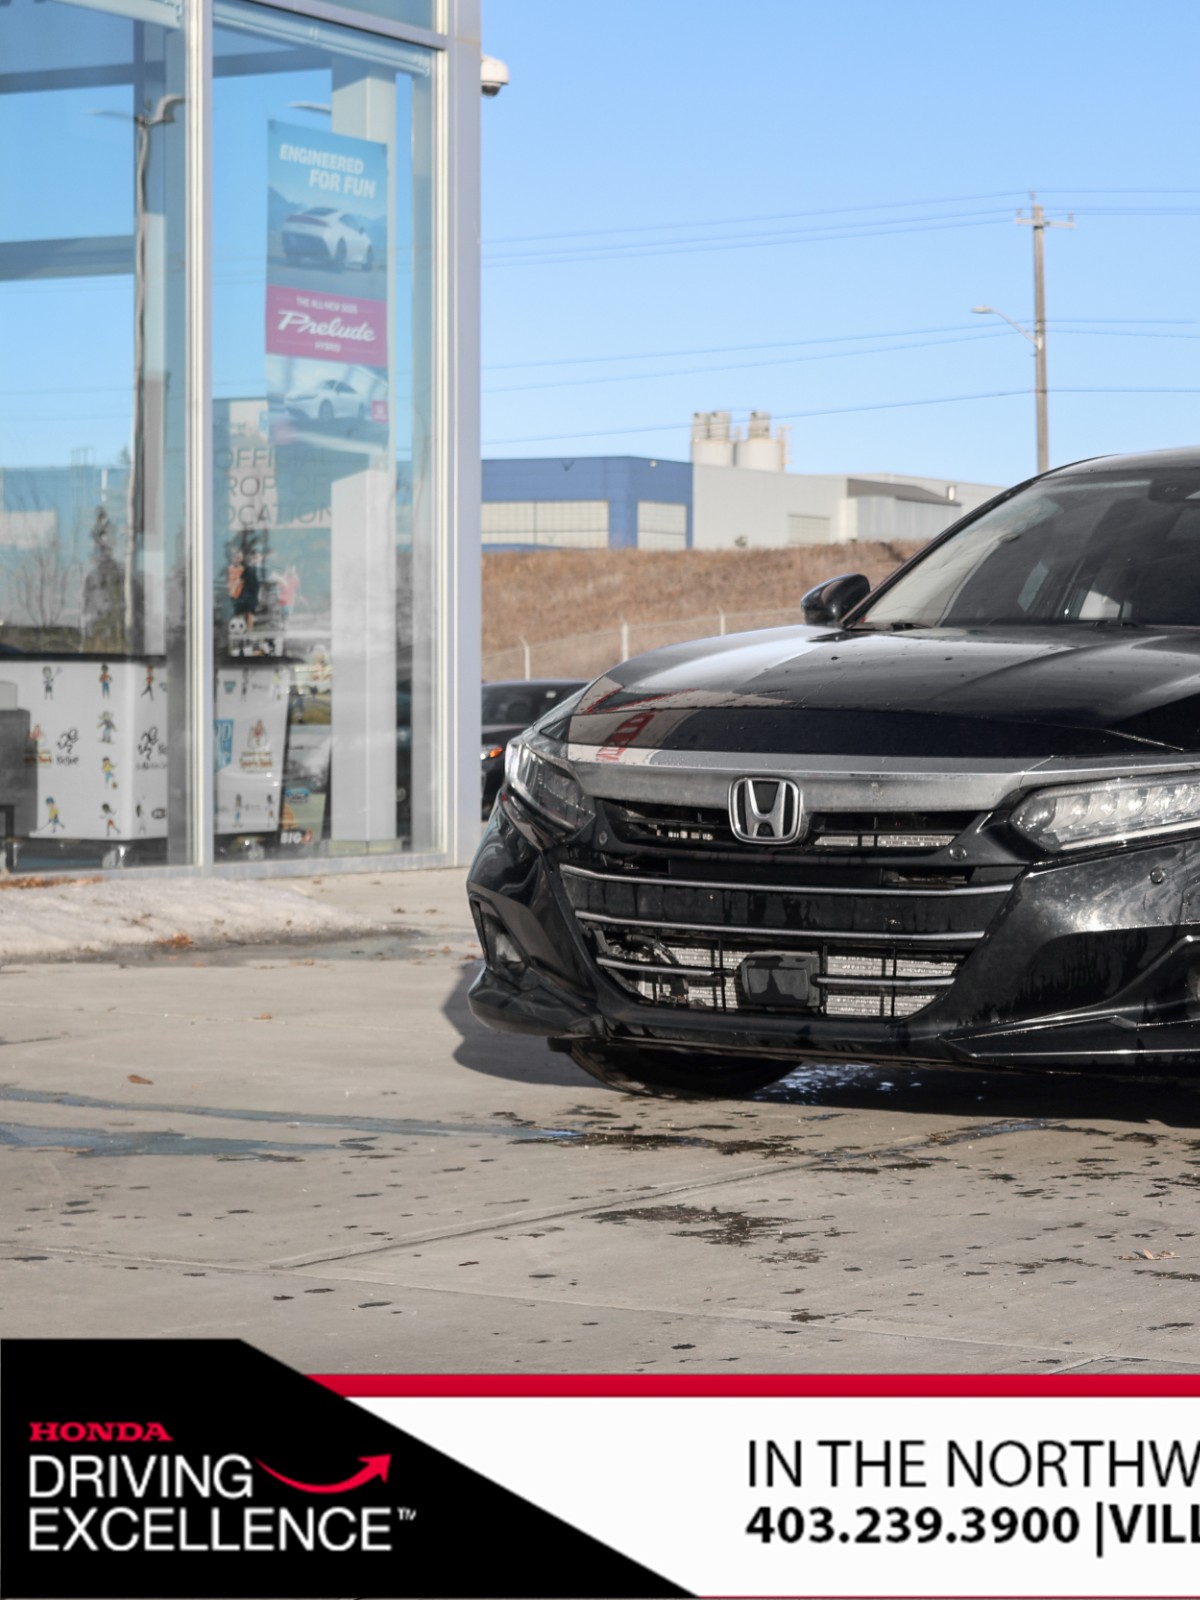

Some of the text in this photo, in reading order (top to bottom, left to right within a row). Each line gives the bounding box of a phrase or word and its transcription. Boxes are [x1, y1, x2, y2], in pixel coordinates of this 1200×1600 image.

[280, 144, 364, 174] ENGINEERED
[309, 168, 376, 199] FOR FUN
[277, 309, 376, 341] Prelude
[214, 503, 331, 525] OCATION
